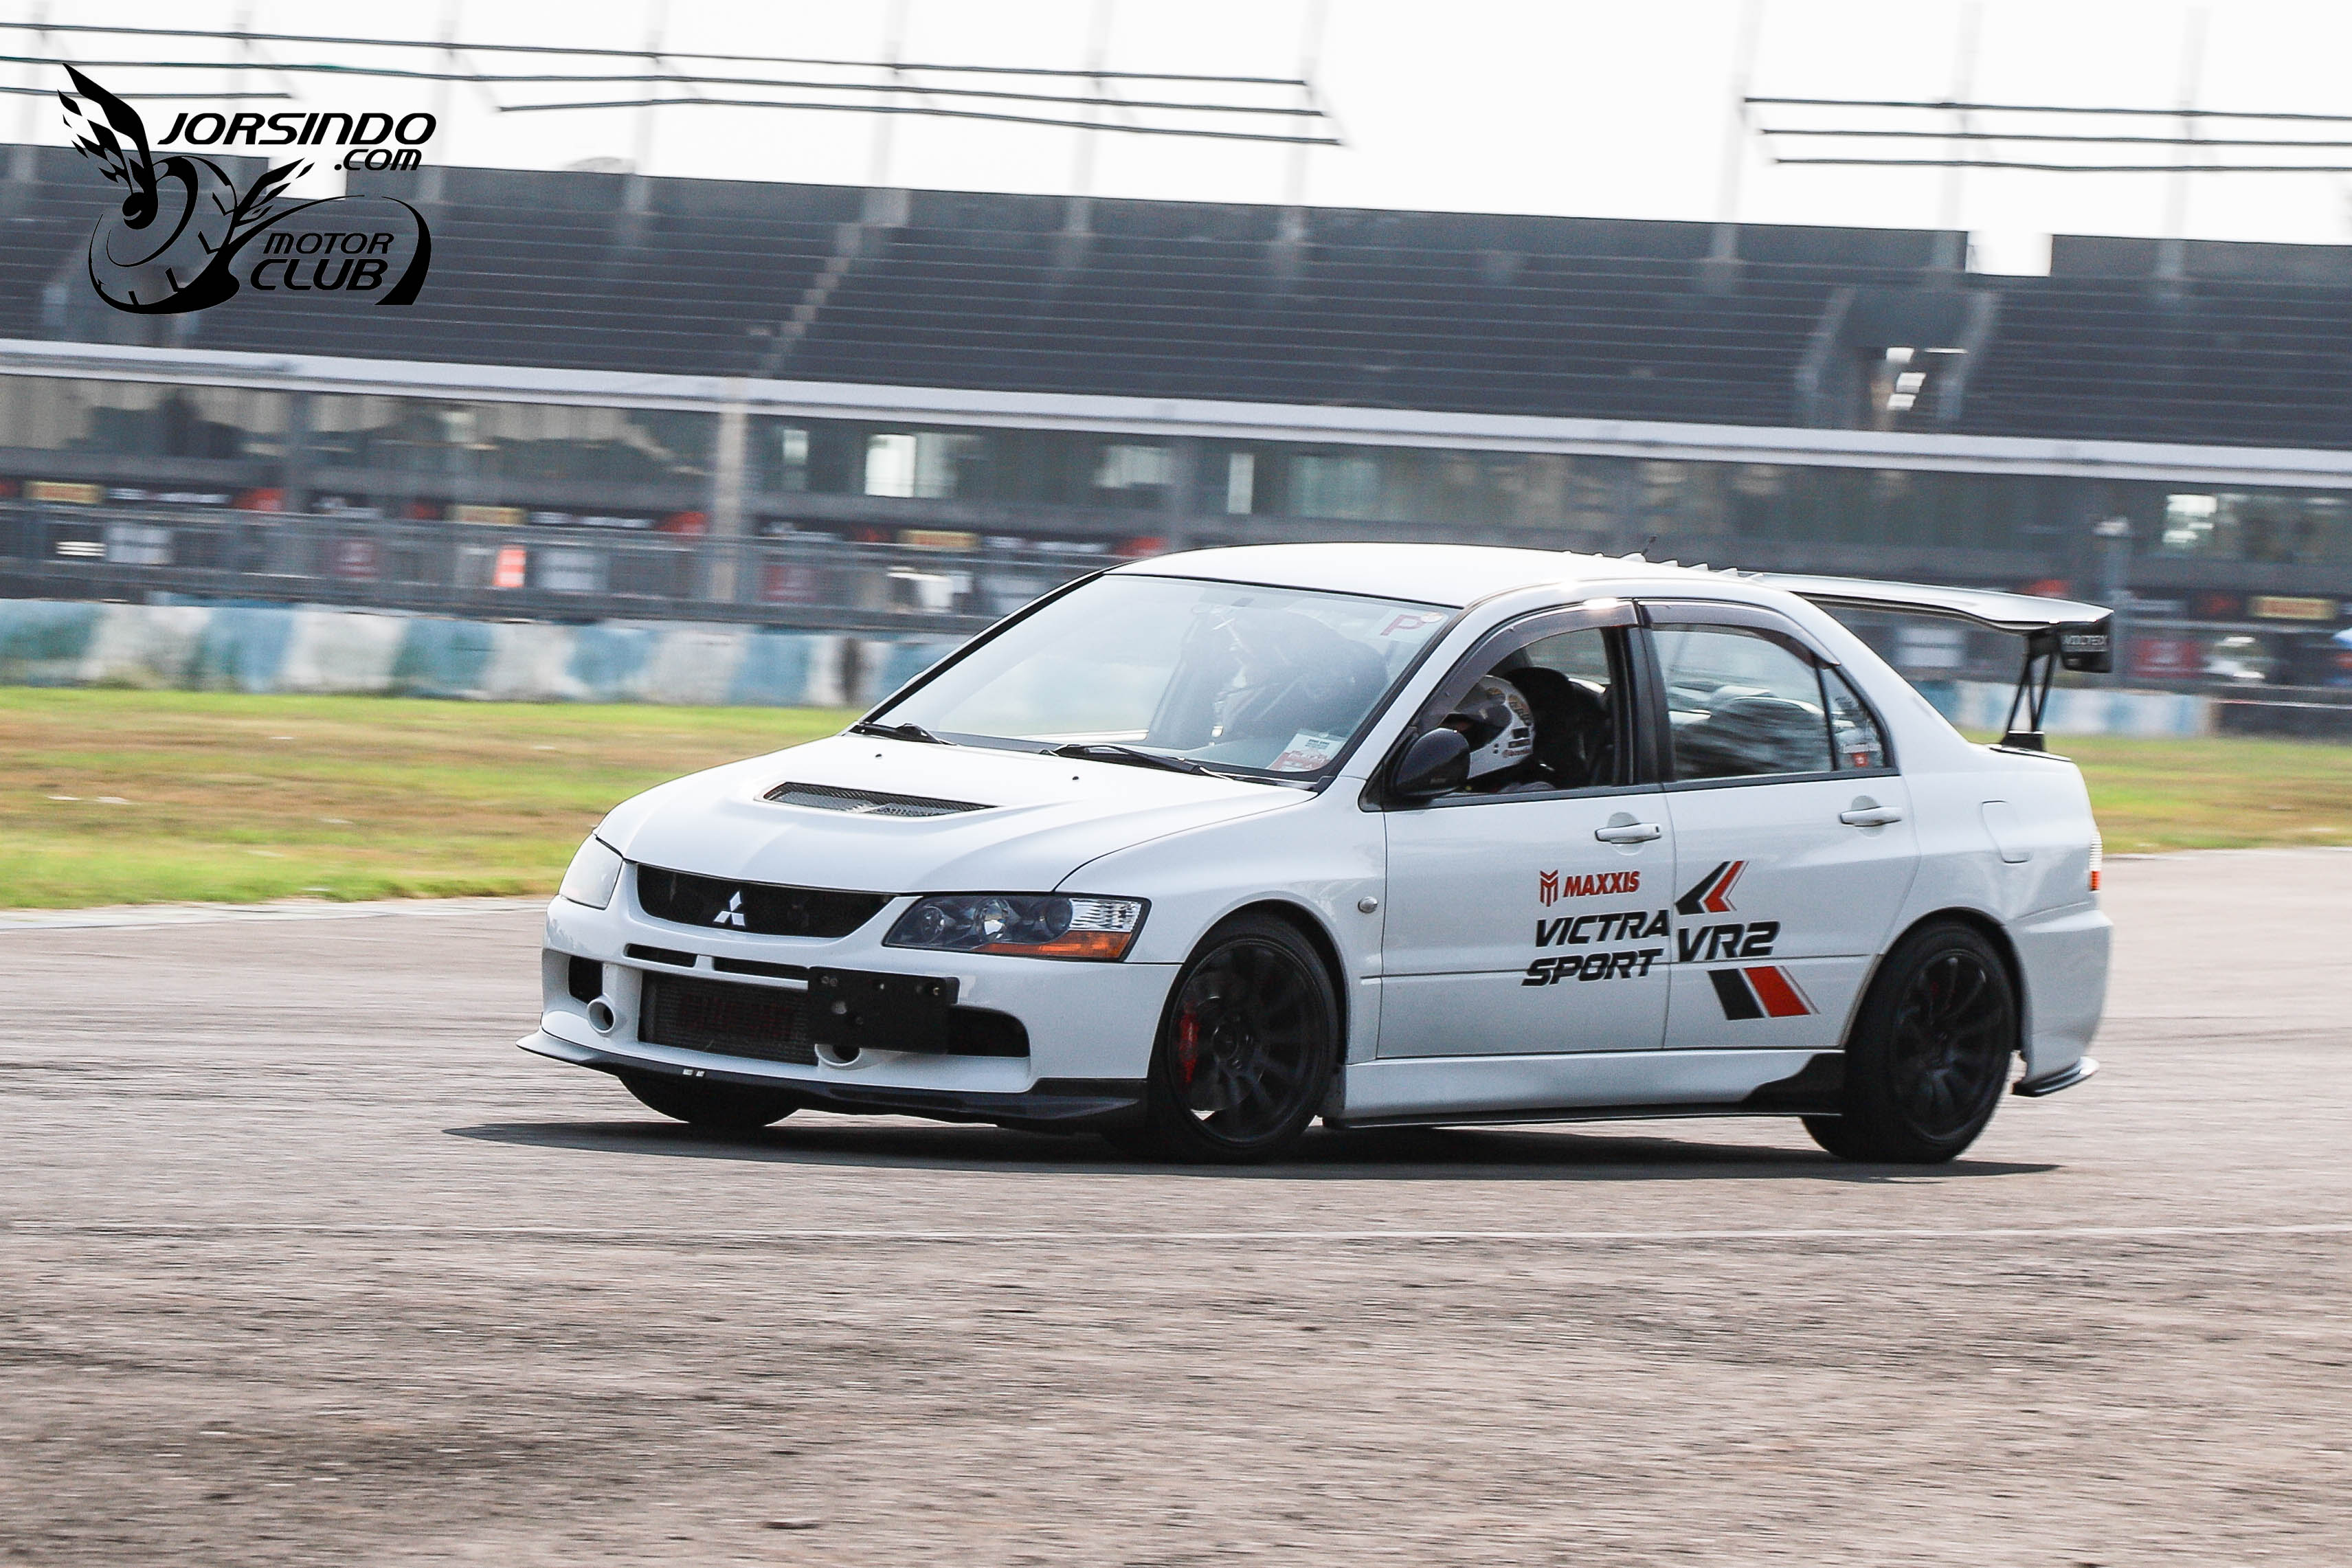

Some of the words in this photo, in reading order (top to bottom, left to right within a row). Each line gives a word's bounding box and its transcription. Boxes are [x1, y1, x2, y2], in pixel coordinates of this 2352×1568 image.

[1563, 871, 1640, 897] MAXXIS
[1535, 909, 1670, 948] VICTRA
[1676, 921, 1781, 962] VR2
[1521, 948, 1664, 987] SPORT
